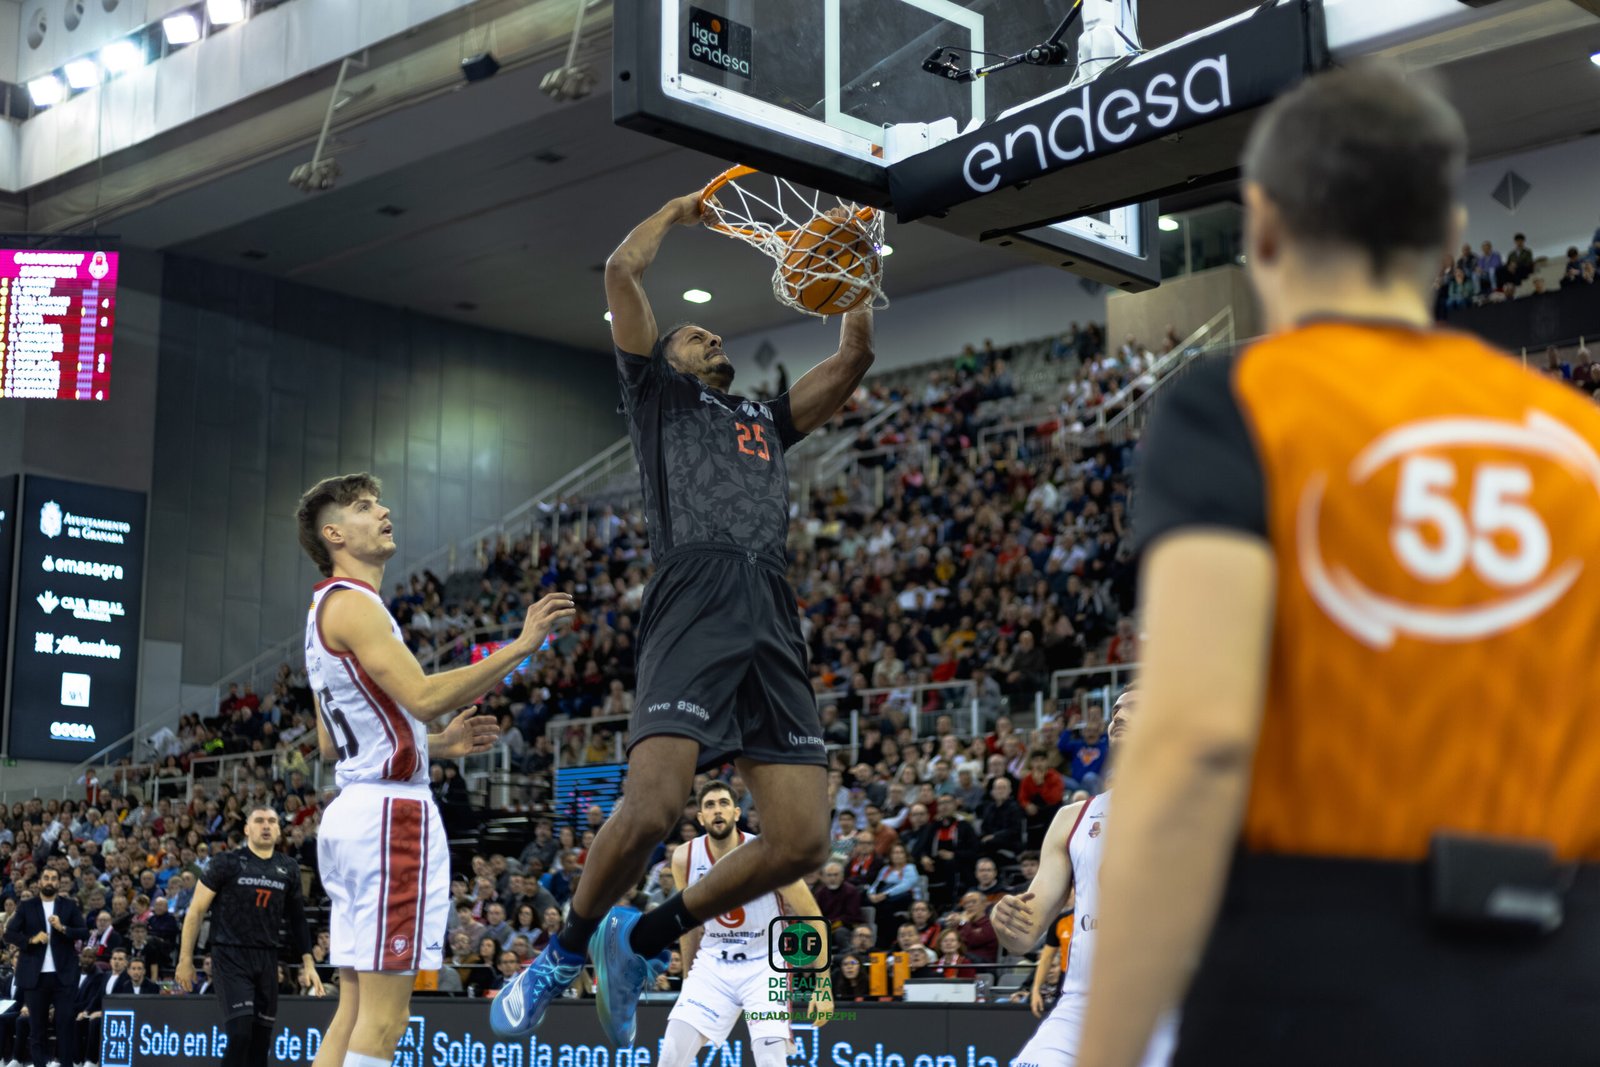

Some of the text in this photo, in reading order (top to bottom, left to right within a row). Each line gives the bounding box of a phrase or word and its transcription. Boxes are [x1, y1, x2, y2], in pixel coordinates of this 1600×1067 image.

[692, 22, 718, 45] liga
[692, 43, 749, 74] endesa
[963, 54, 1231, 193] endesa
[735, 421, 770, 460] 25
[1389, 454, 1552, 588] 55
[55, 558, 124, 581] emasagra
[648, 702, 671, 713] vive
[255, 888, 272, 909] 77
[140, 1024, 180, 1056] Solo
[183, 1032, 207, 1057] en
[275, 1027, 301, 1060] de
[432, 1032, 486, 1067] Solo
[491, 1042, 523, 1067] en
[529, 1034, 552, 1067] la
